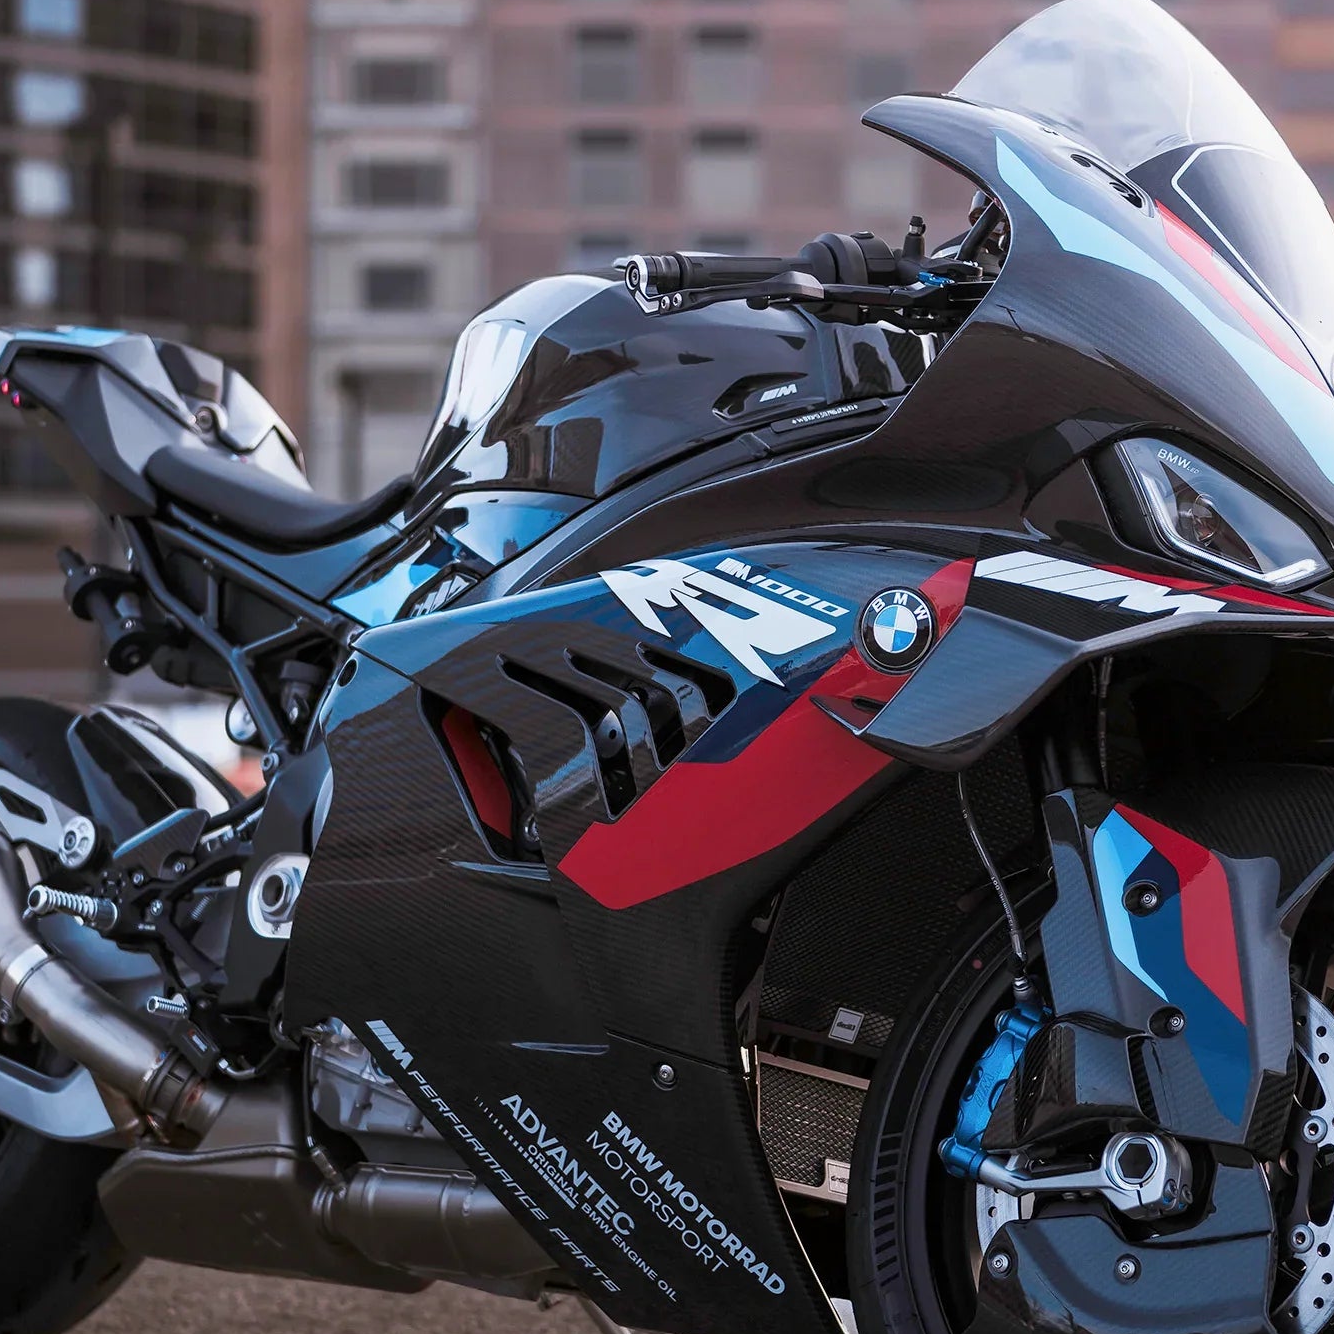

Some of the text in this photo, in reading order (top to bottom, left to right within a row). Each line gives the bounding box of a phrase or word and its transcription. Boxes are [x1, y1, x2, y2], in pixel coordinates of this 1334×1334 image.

[1157, 448, 1191, 469] BMW
[871, 591, 929, 621] BMW
[407, 1069, 548, 1221] PERFORMANCE
[549, 1227, 620, 1293] PARTS
[500, 1094, 638, 1236] ADVANTEC
[527, 1143, 678, 1303] ORIGINAL BMW ENGINE OIL
[586, 1129, 730, 1273] MOTORSPORT
[601, 1110, 786, 1296] BMW MOTORRAD
